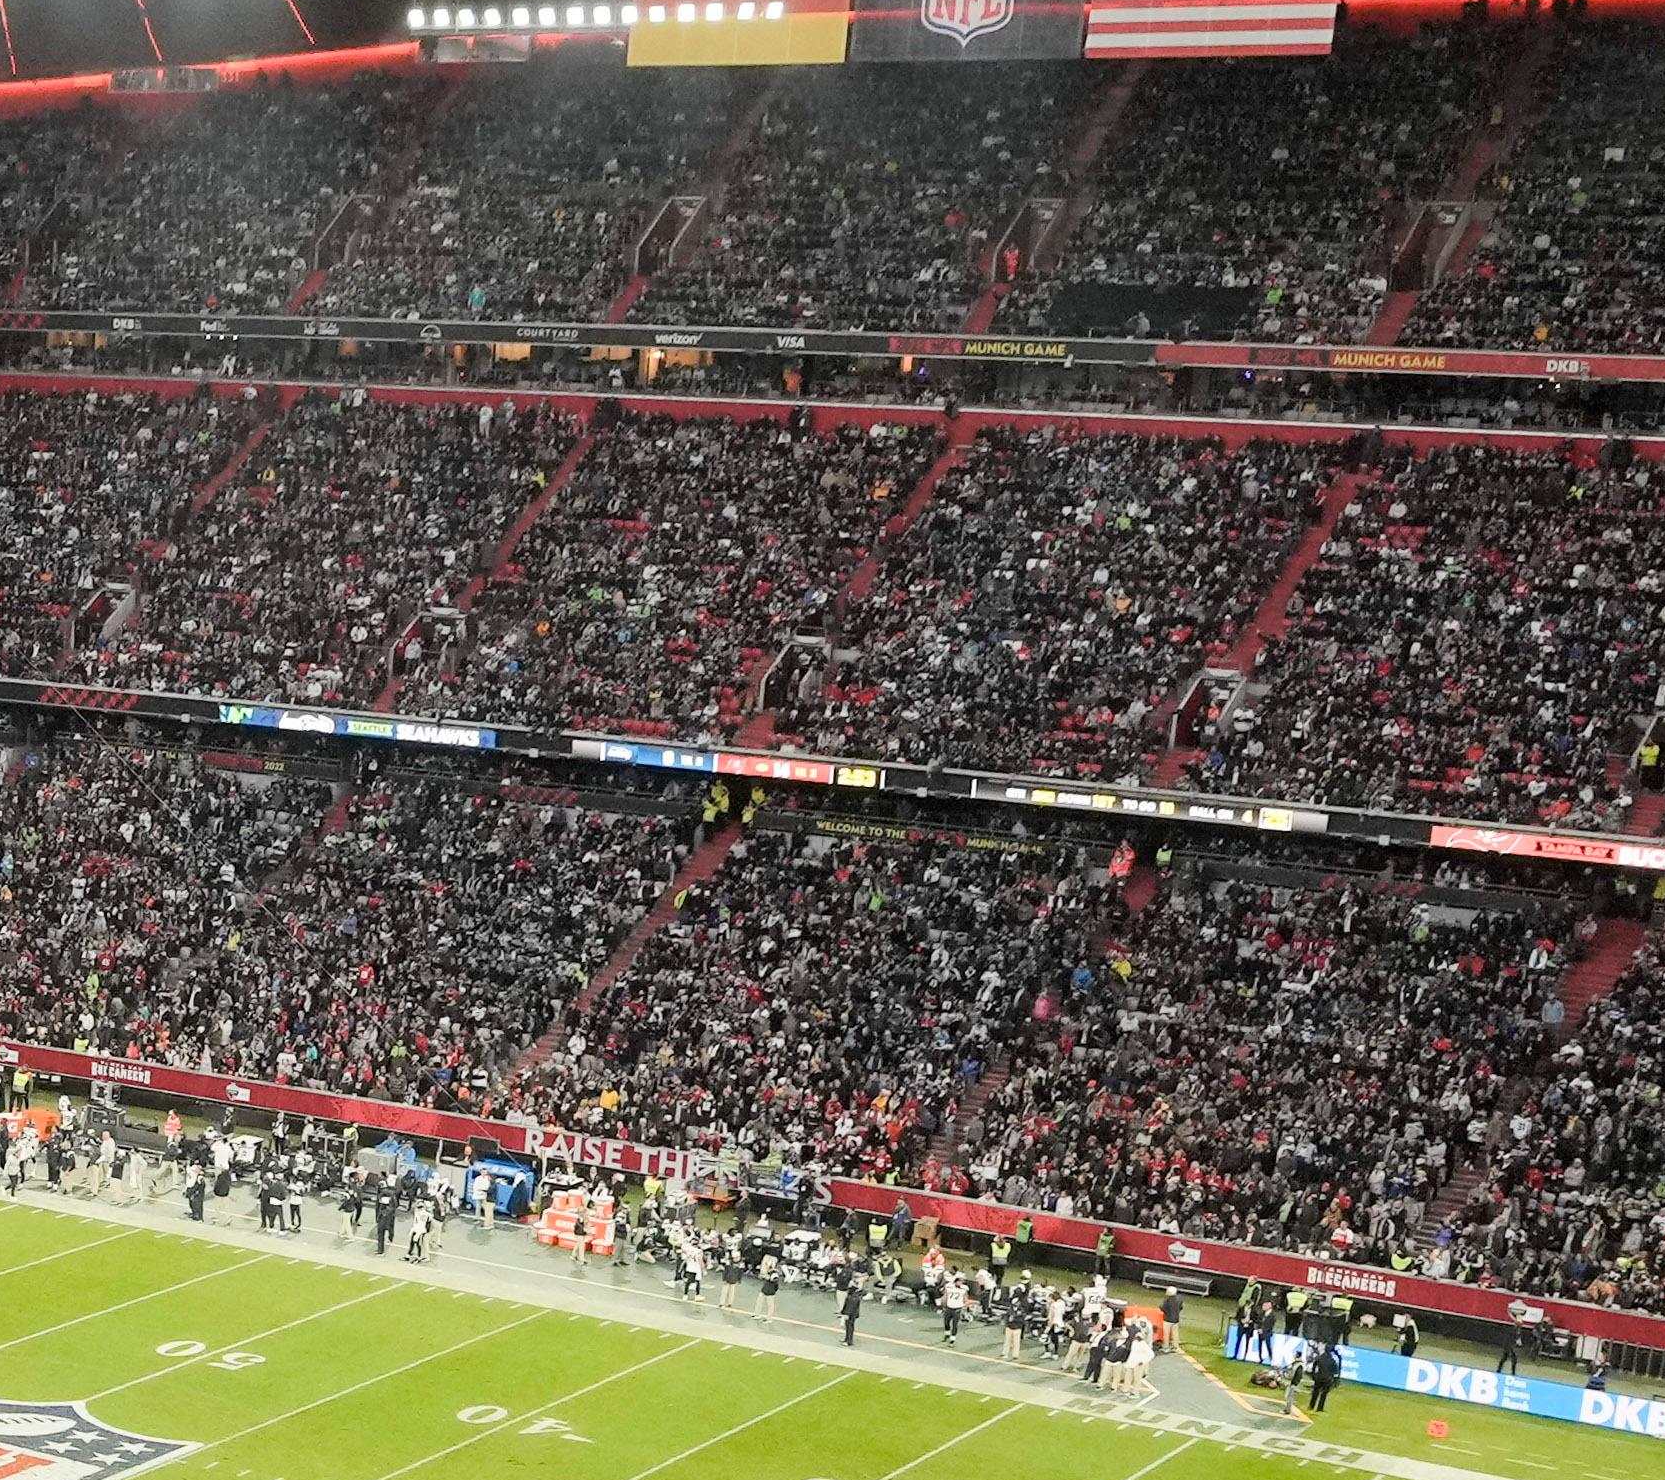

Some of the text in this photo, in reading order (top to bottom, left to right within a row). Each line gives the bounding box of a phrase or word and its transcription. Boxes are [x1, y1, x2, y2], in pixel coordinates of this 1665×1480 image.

[517, 327, 578, 339] COURTYARD
[655, 333, 703, 346] verizon
[777, 336, 805, 349] VISA
[965, 342, 1022, 356] MUNICH
[1023, 344, 1066, 357] GAME
[1333, 353, 1396, 368] MUNICH
[1399, 355, 1446, 369] GAME
[1546, 360, 1579, 373] DKB
[352, 721, 388, 735] SEATTLE
[396, 724, 480, 747] SEAHAWKS
[816, 819, 906, 840] WELCOME TO THE
[1542, 842, 1613, 860] TAMPA BAY
[91, 1061, 151, 1085] BUCCANEERS
[525, 1125, 622, 1170] RAISE
[1307, 1266, 1396, 1298] BUCCANEERS
[154, 1339, 267, 1371] 50
[1405, 1356, 1499, 1406] DKB
[1504, 1373, 1527, 1390] Das
[454, 1403, 571, 1438] 40
[1064, 1399, 1365, 1468] MUNICH
